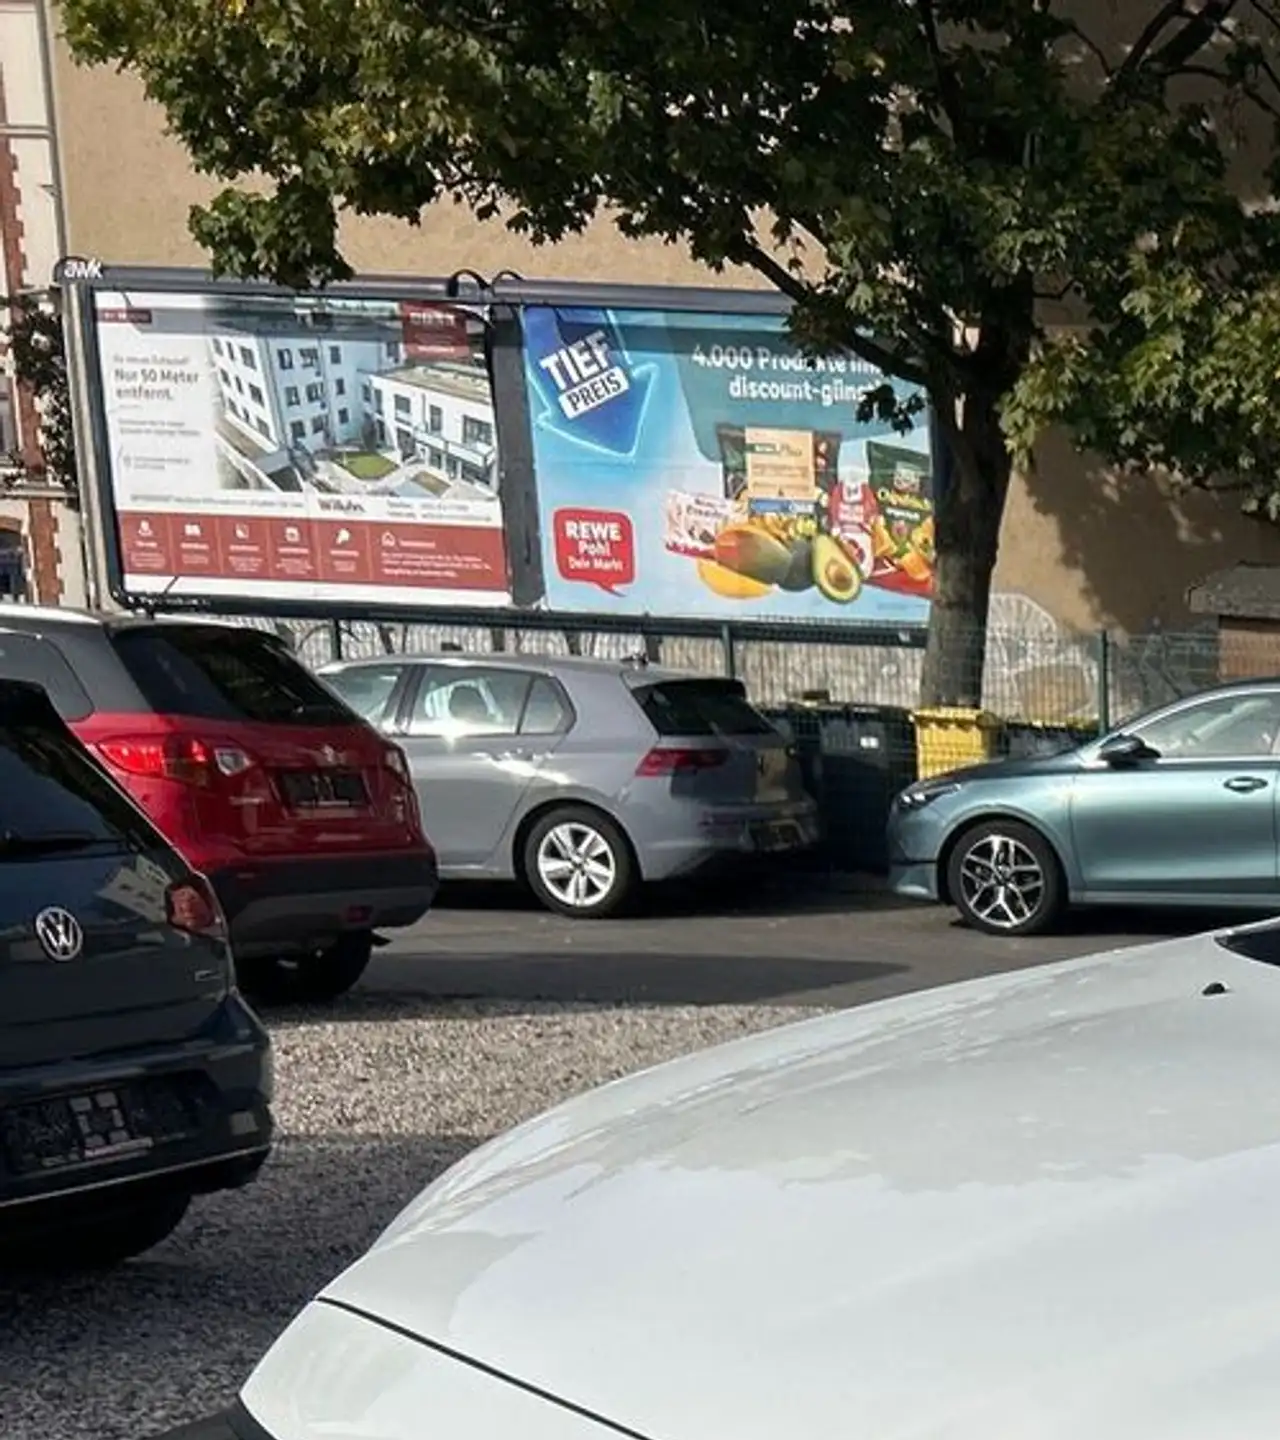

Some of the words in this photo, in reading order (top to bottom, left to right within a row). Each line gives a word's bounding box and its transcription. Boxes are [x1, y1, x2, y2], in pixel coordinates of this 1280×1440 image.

[64, 257, 103, 279] awk
[540, 329, 609, 391] TIEF
[692, 344, 751, 370] 4.000
[115, 369, 138, 383] Nur
[141, 368, 157, 383] 50
[161, 371, 199, 385] Meter
[565, 371, 622, 412] PREIS
[565, 520, 622, 541] REWE
